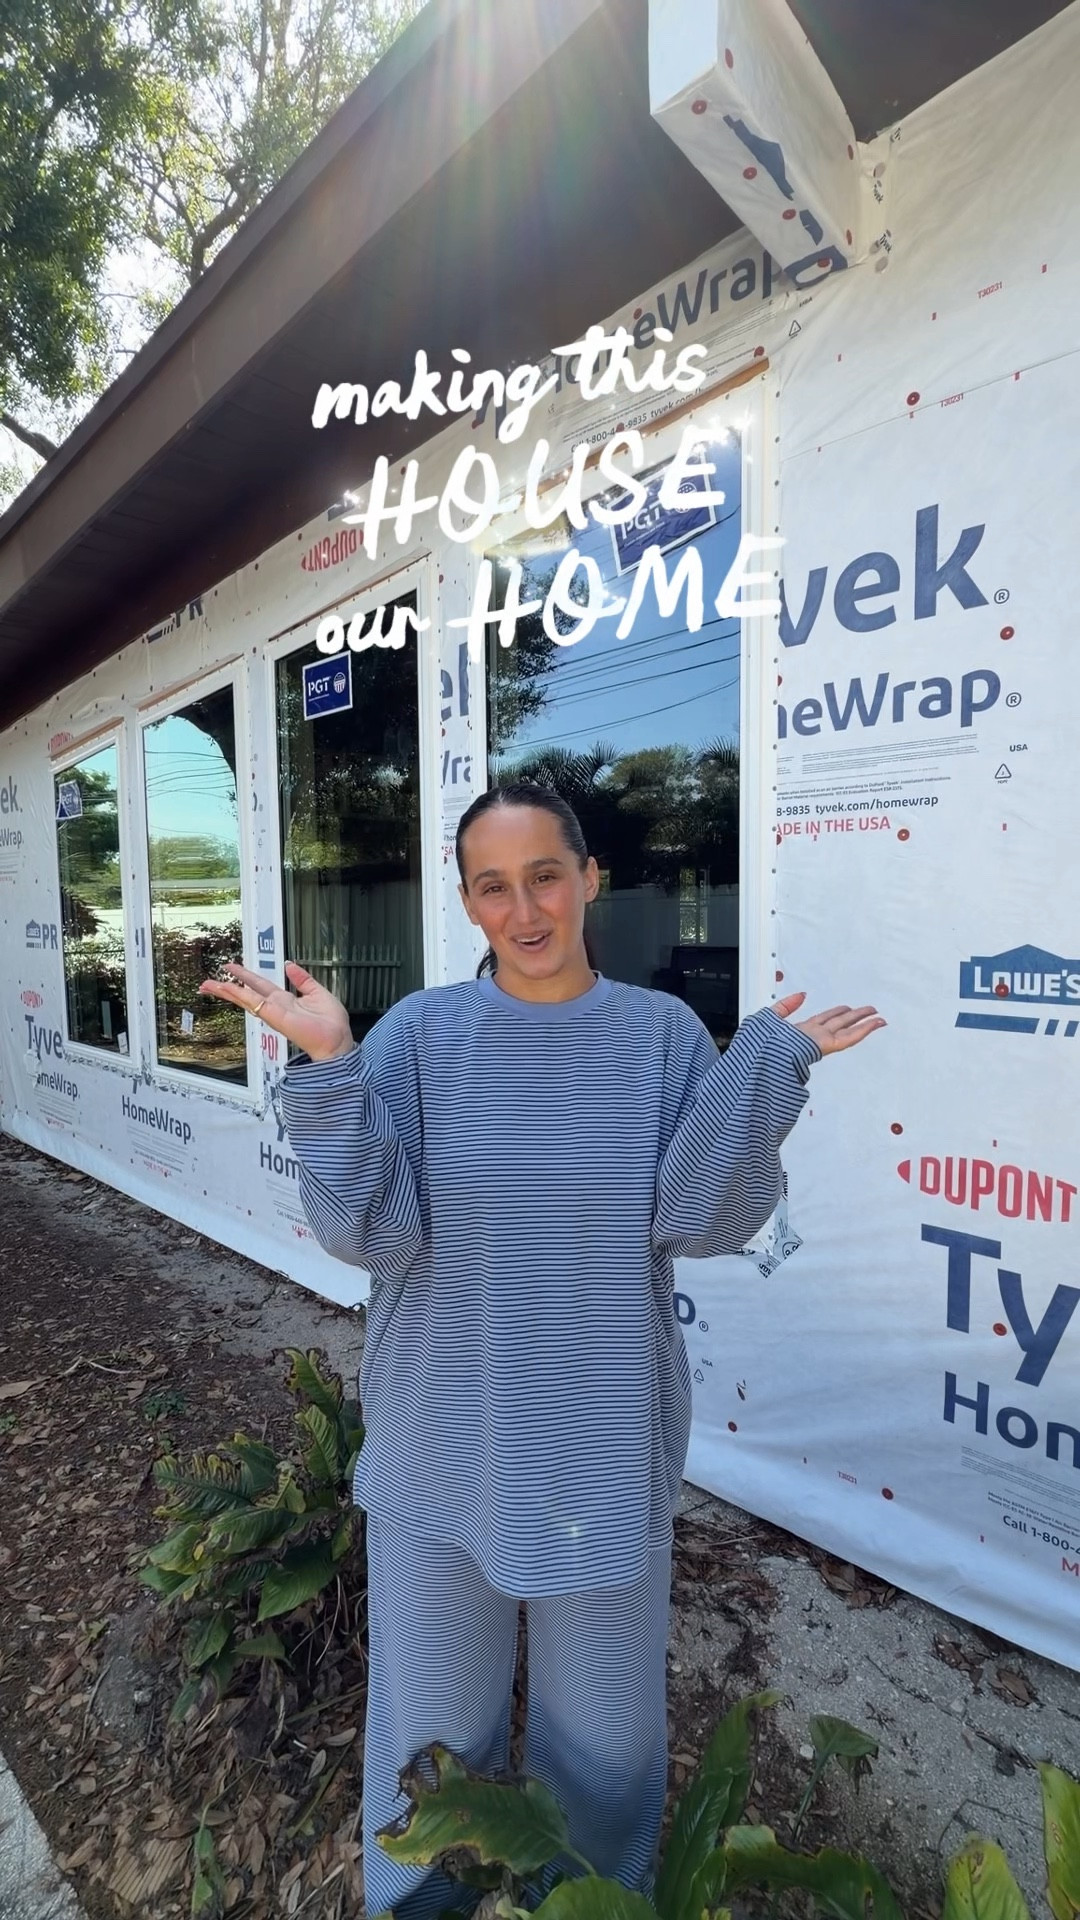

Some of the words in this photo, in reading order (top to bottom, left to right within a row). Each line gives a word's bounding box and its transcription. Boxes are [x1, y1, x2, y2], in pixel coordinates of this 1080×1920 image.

[308, 676, 332, 697] PGT
[1009, 743, 1028, 752] USA
[815, 795, 939, 815] tyvek.com/homewrap
[805, 821, 821, 834] IN
[824, 818, 855, 833] THE
[858, 816, 891, 831] USA
[122, 1094, 192, 1145] HomeWrap
[920, 1156, 1078, 1222] DUPONT
[921, 1223, 1080, 1388] Ty
[1002, 1515, 1028, 1535] Call
